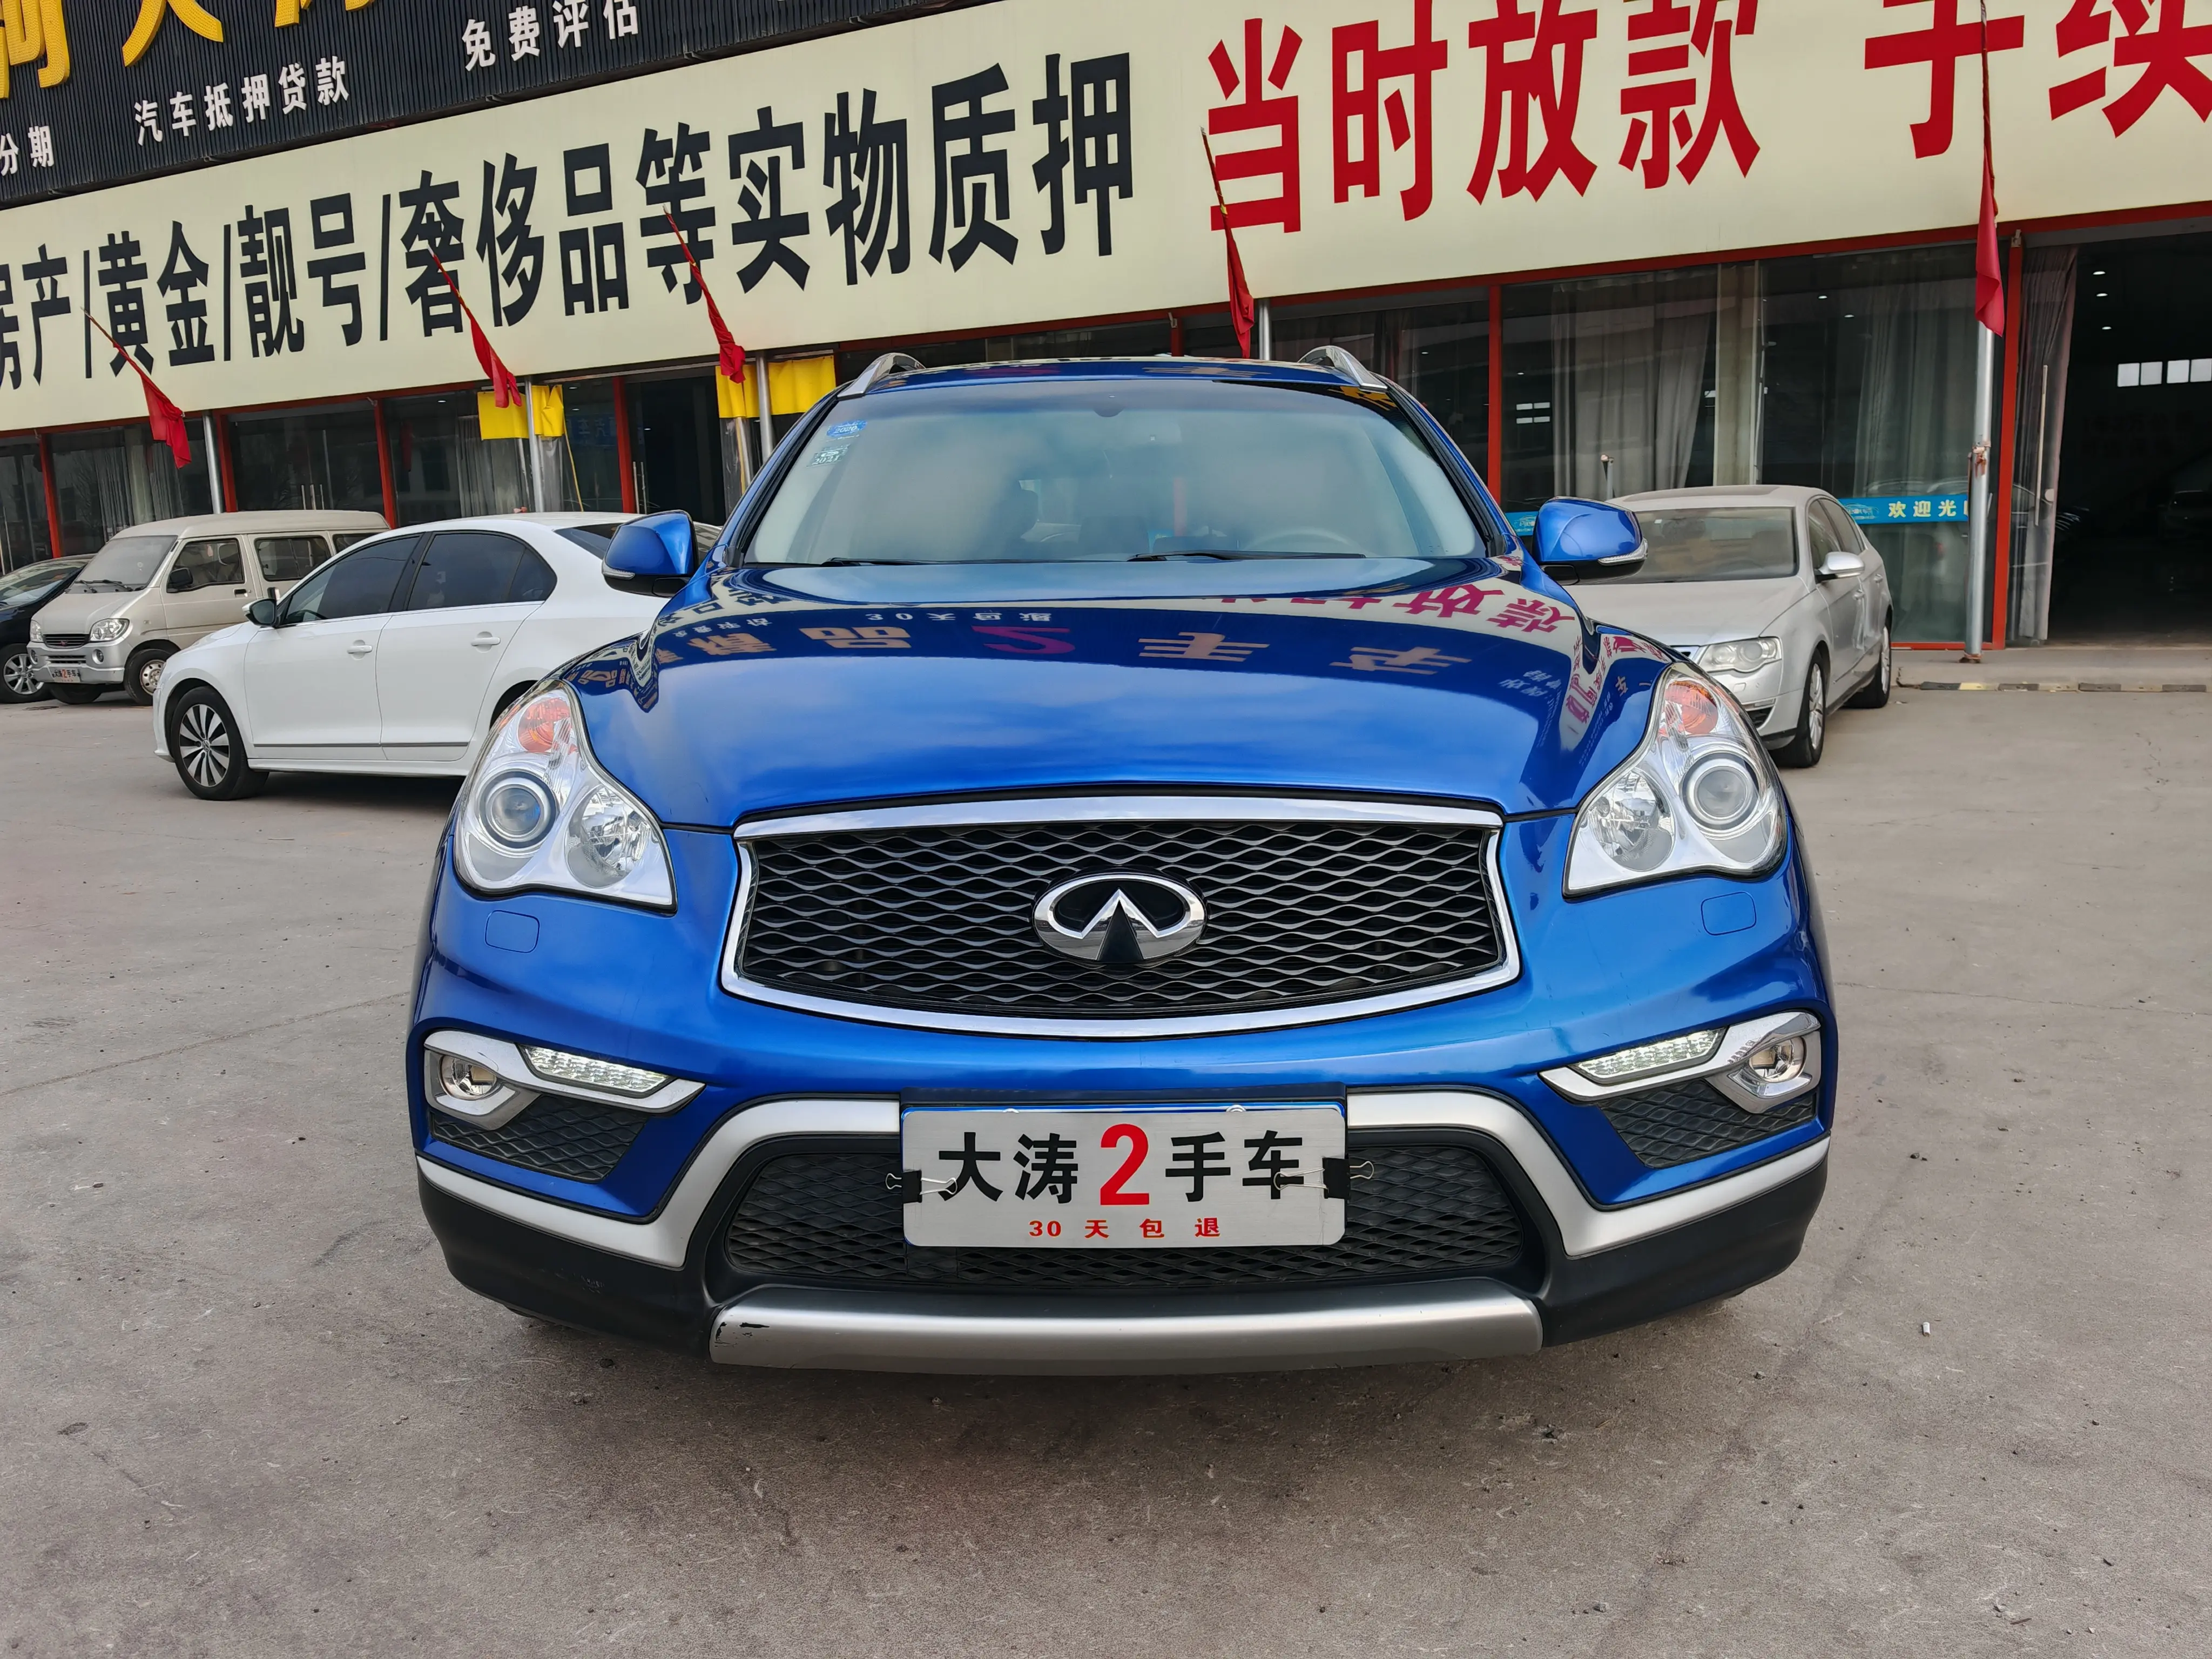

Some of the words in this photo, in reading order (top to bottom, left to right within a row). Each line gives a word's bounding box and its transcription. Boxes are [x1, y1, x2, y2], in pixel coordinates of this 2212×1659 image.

[134, 56, 349, 146] 汽车抵押贷款
[462, 0, 639, 71] 免费评估
[1208, 0, 1761, 233] 当时放款
[1888, 500, 1967, 518] 欢迎光
[938, 1123, 1304, 1206] 大涛2手车
[1029, 1217, 1221, 1239] 30天包退
